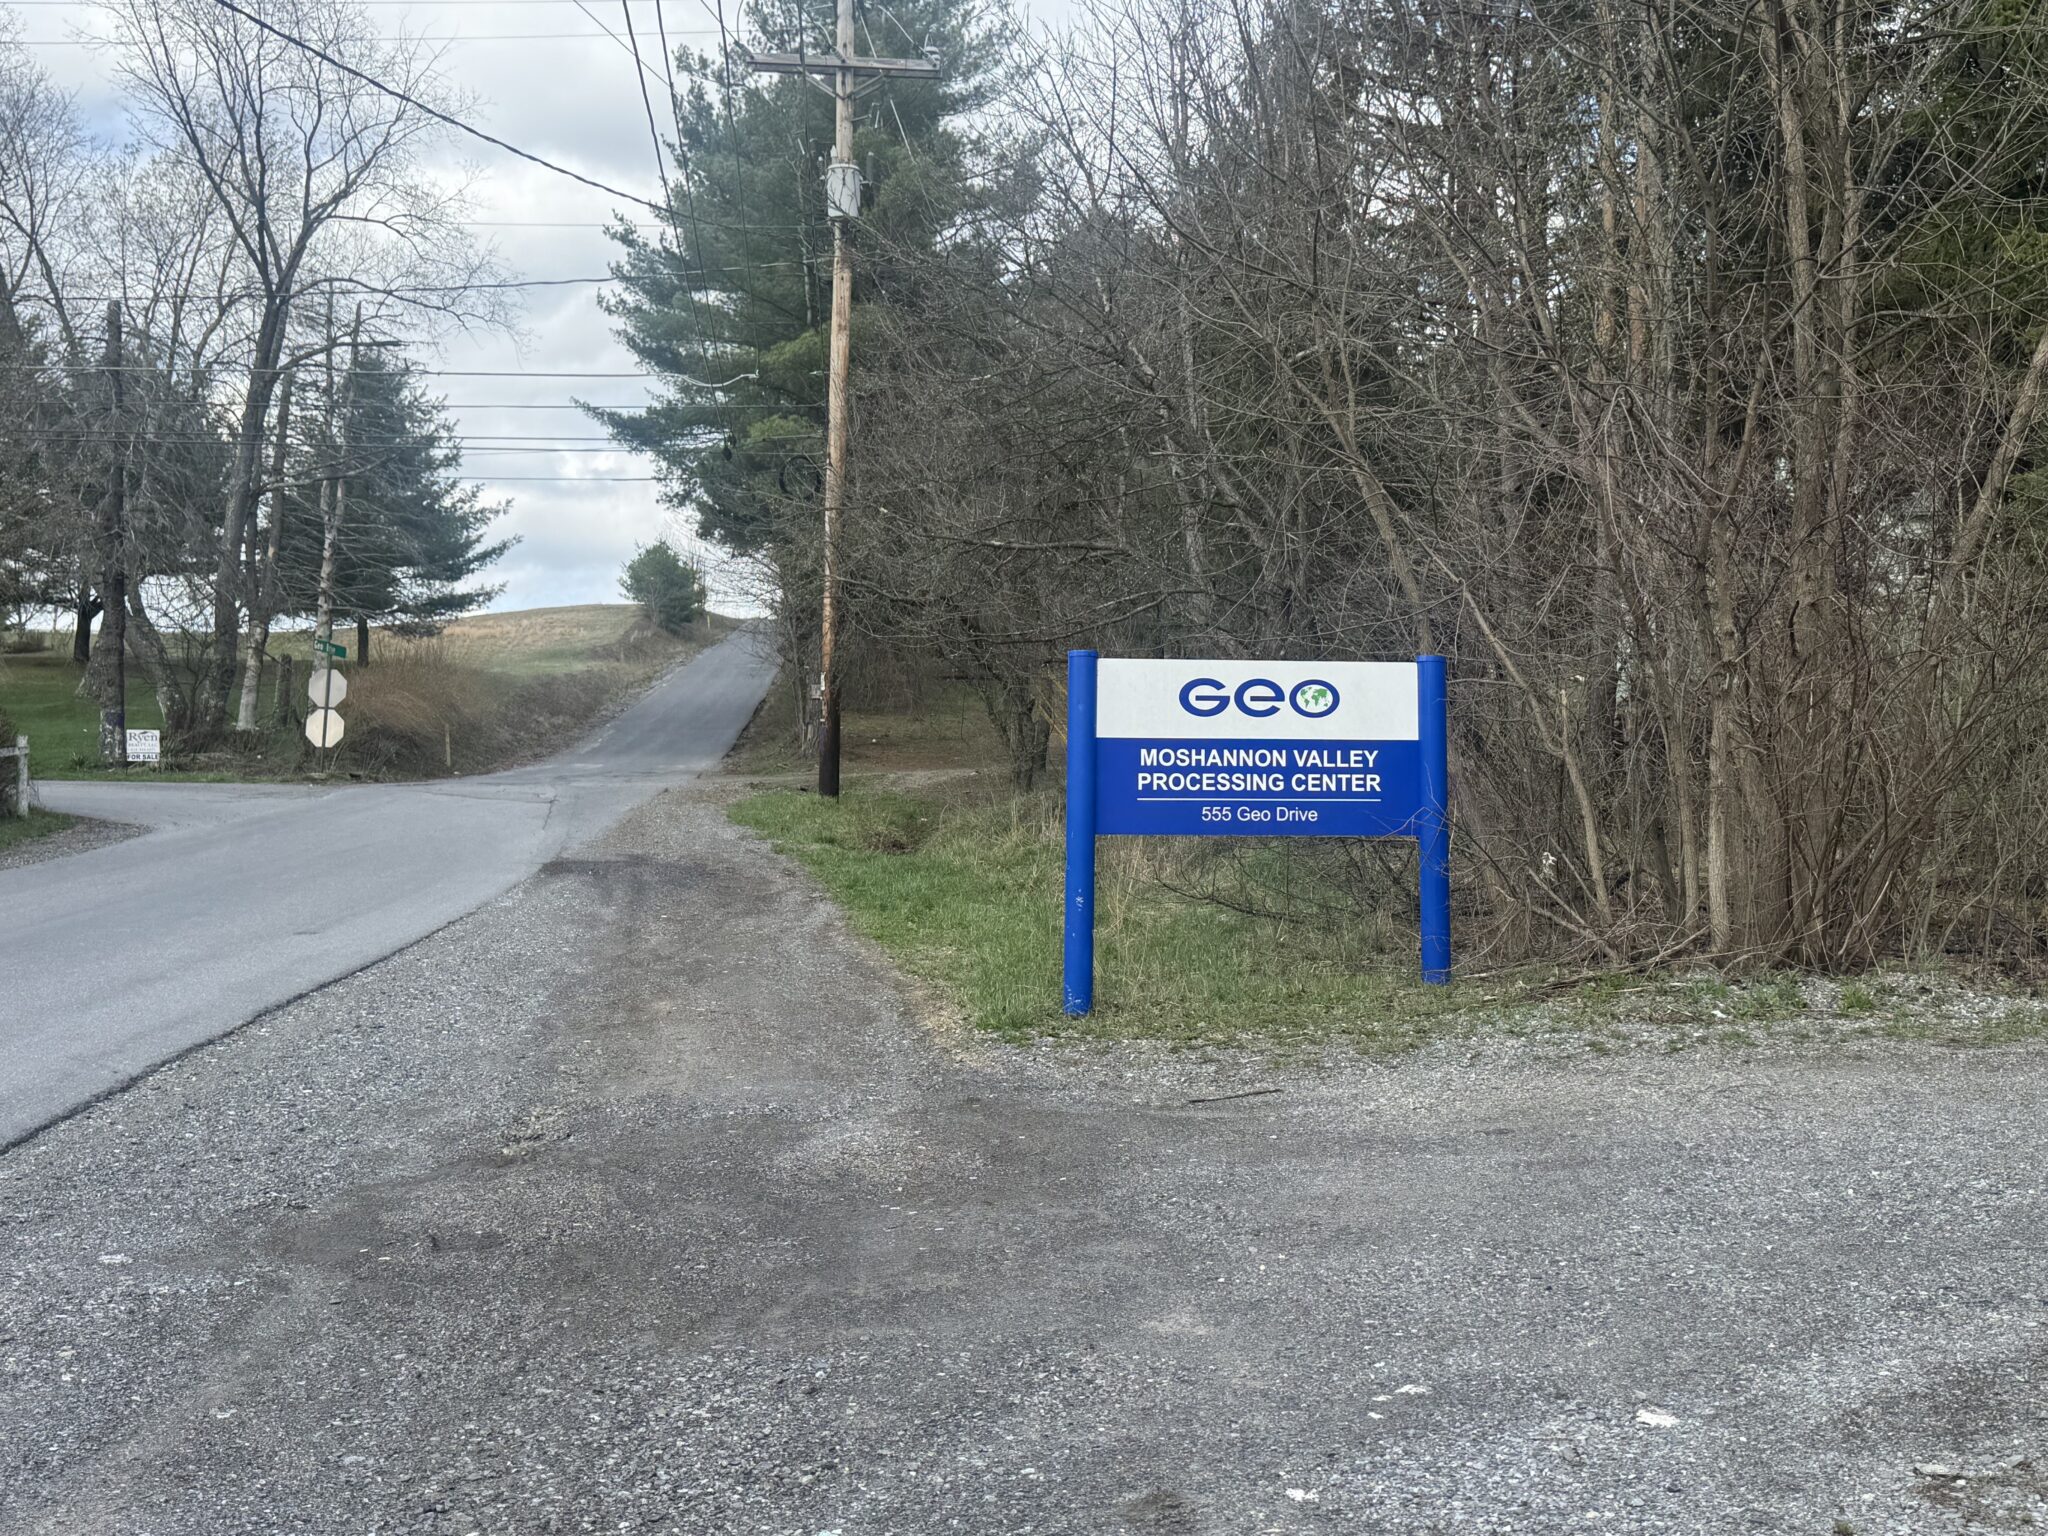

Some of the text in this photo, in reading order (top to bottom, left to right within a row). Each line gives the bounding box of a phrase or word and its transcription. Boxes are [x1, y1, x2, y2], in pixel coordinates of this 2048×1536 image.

[1140, 748, 1379, 768] MOSHANNON VALLEY
[1137, 772, 1382, 792] PROCESSING CENTER
[1201, 806, 1318, 822] 555 Geo Drive
